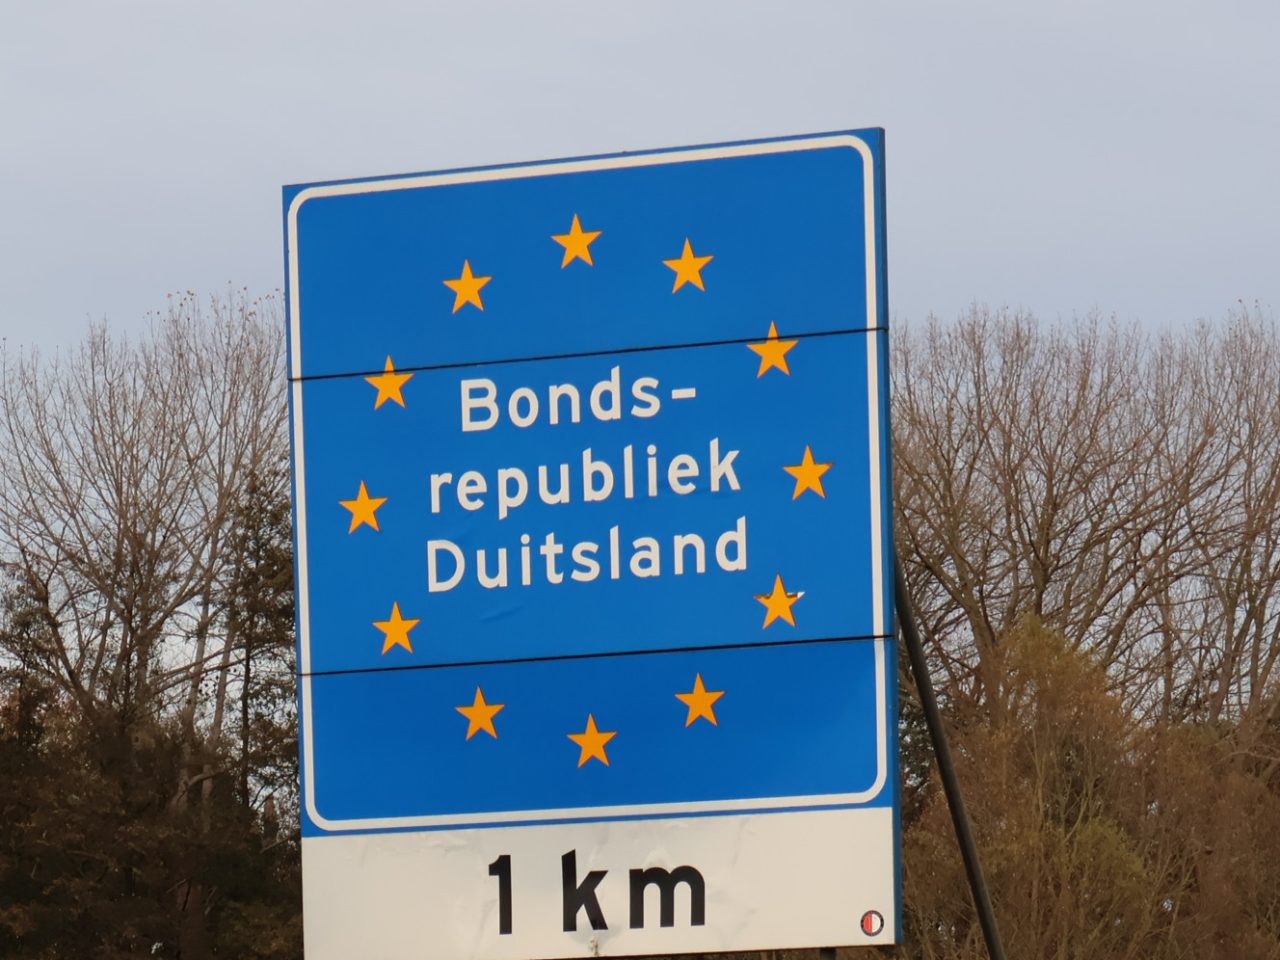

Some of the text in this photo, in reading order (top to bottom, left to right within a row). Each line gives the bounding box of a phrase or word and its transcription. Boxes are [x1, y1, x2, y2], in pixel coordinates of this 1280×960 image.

[460, 365, 698, 432] Bonds-
[428, 437, 742, 520] republiek
[426, 515, 748, 594] Duitsland
[488, 849, 707, 935] 1 km
